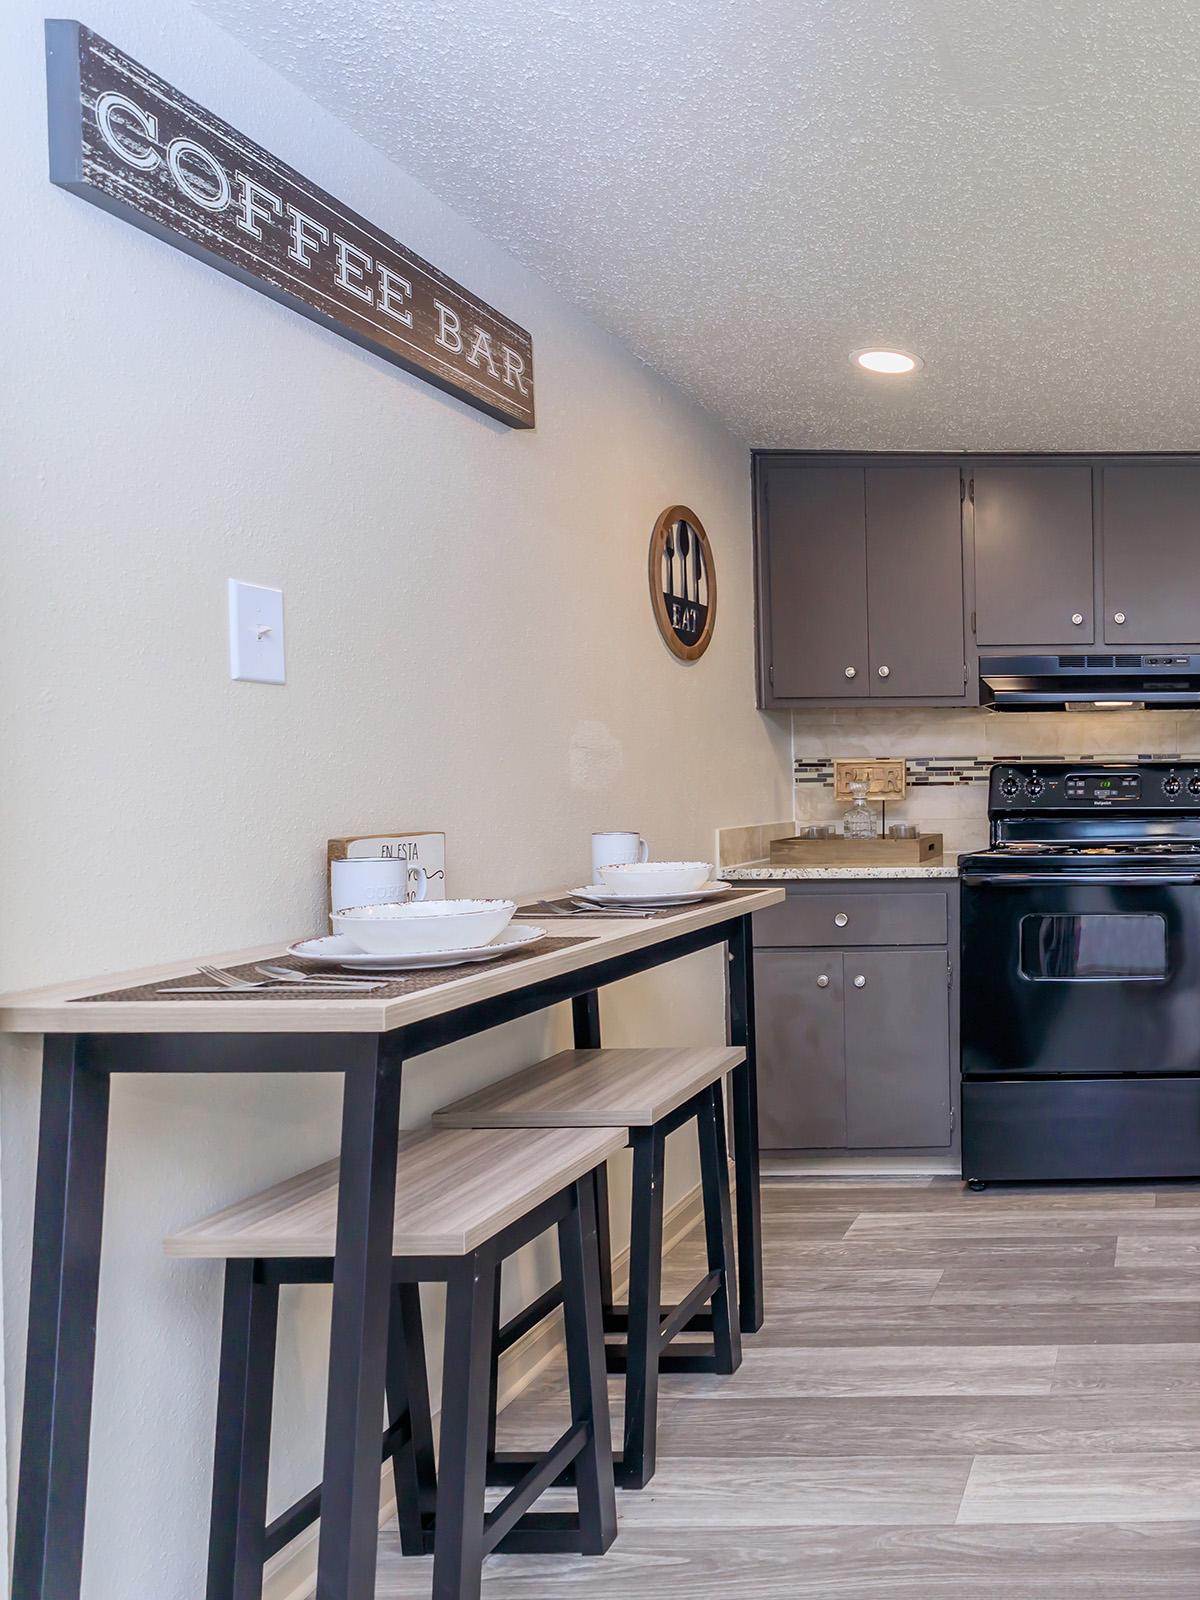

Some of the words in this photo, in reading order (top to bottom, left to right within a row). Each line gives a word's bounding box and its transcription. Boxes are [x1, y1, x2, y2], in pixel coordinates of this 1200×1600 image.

[95, 90, 415, 329] COFFEE
[433, 299, 529, 397] BAR
[671, 603, 699, 633] EAT
[381, 845, 393, 858] EN
[397, 842, 419, 861] ESTA
